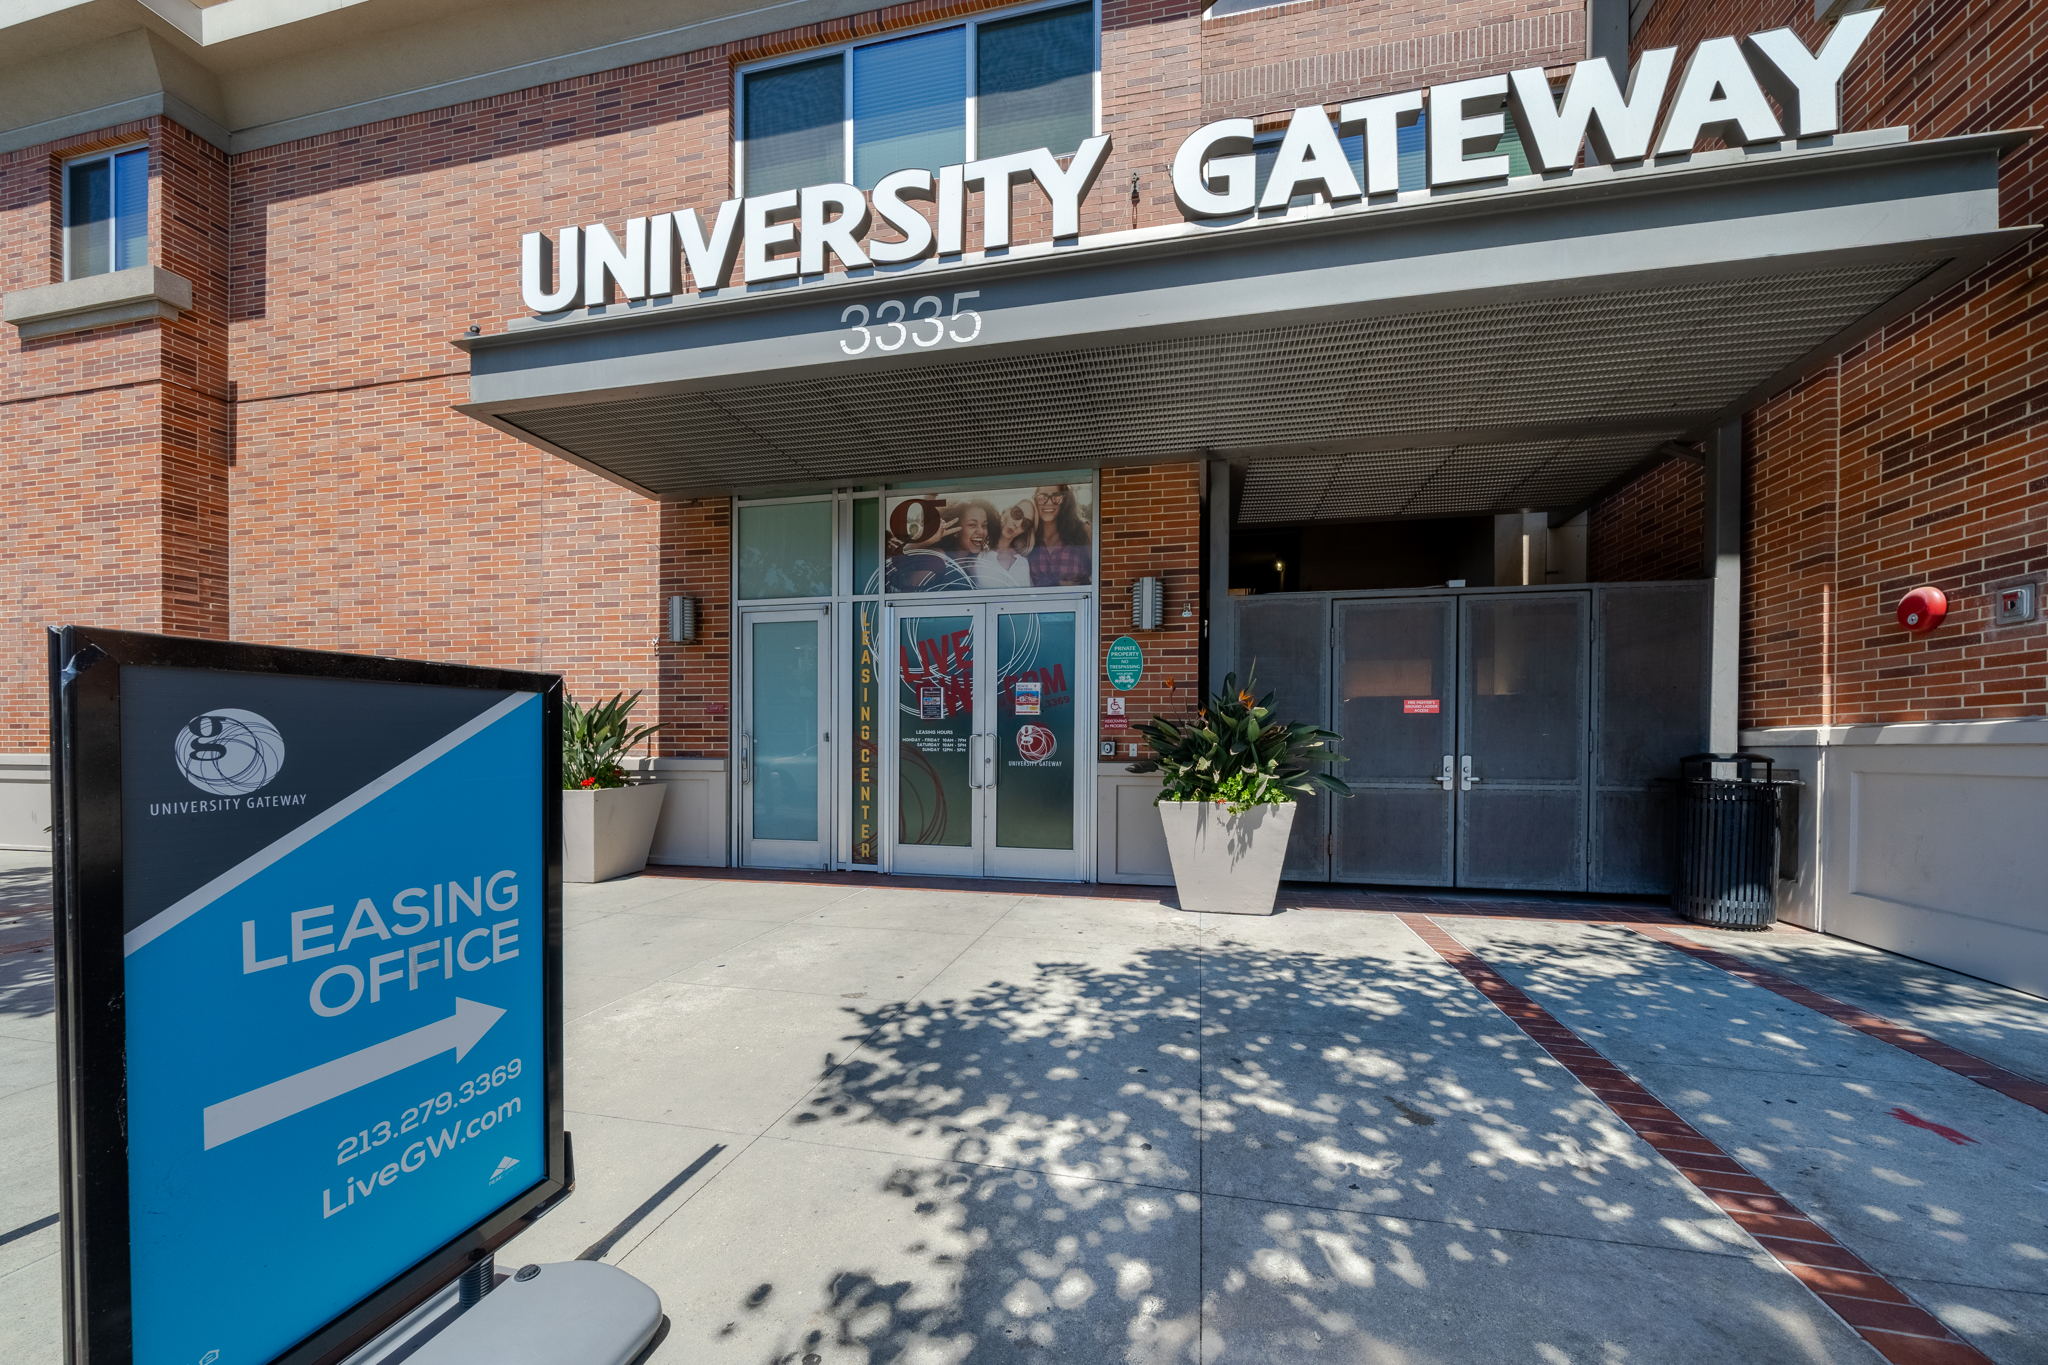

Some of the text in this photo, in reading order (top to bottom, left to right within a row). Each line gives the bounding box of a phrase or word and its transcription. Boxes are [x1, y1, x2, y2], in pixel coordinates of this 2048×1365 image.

[521, 6, 1885, 314] UNIVERSITY GATEWAY
[839, 290, 982, 355] 3335
[861, 612, 871, 858] LEASING CENTER
[150, 794, 307, 816] UNIVERSITY GATEWAY
[242, 870, 519, 975] LEASING
[309, 918, 519, 1018] OFFICE
[323, 1096, 521, 1219] LiveGW.com
[337, 1058, 521, 1166] 213.279.3369
